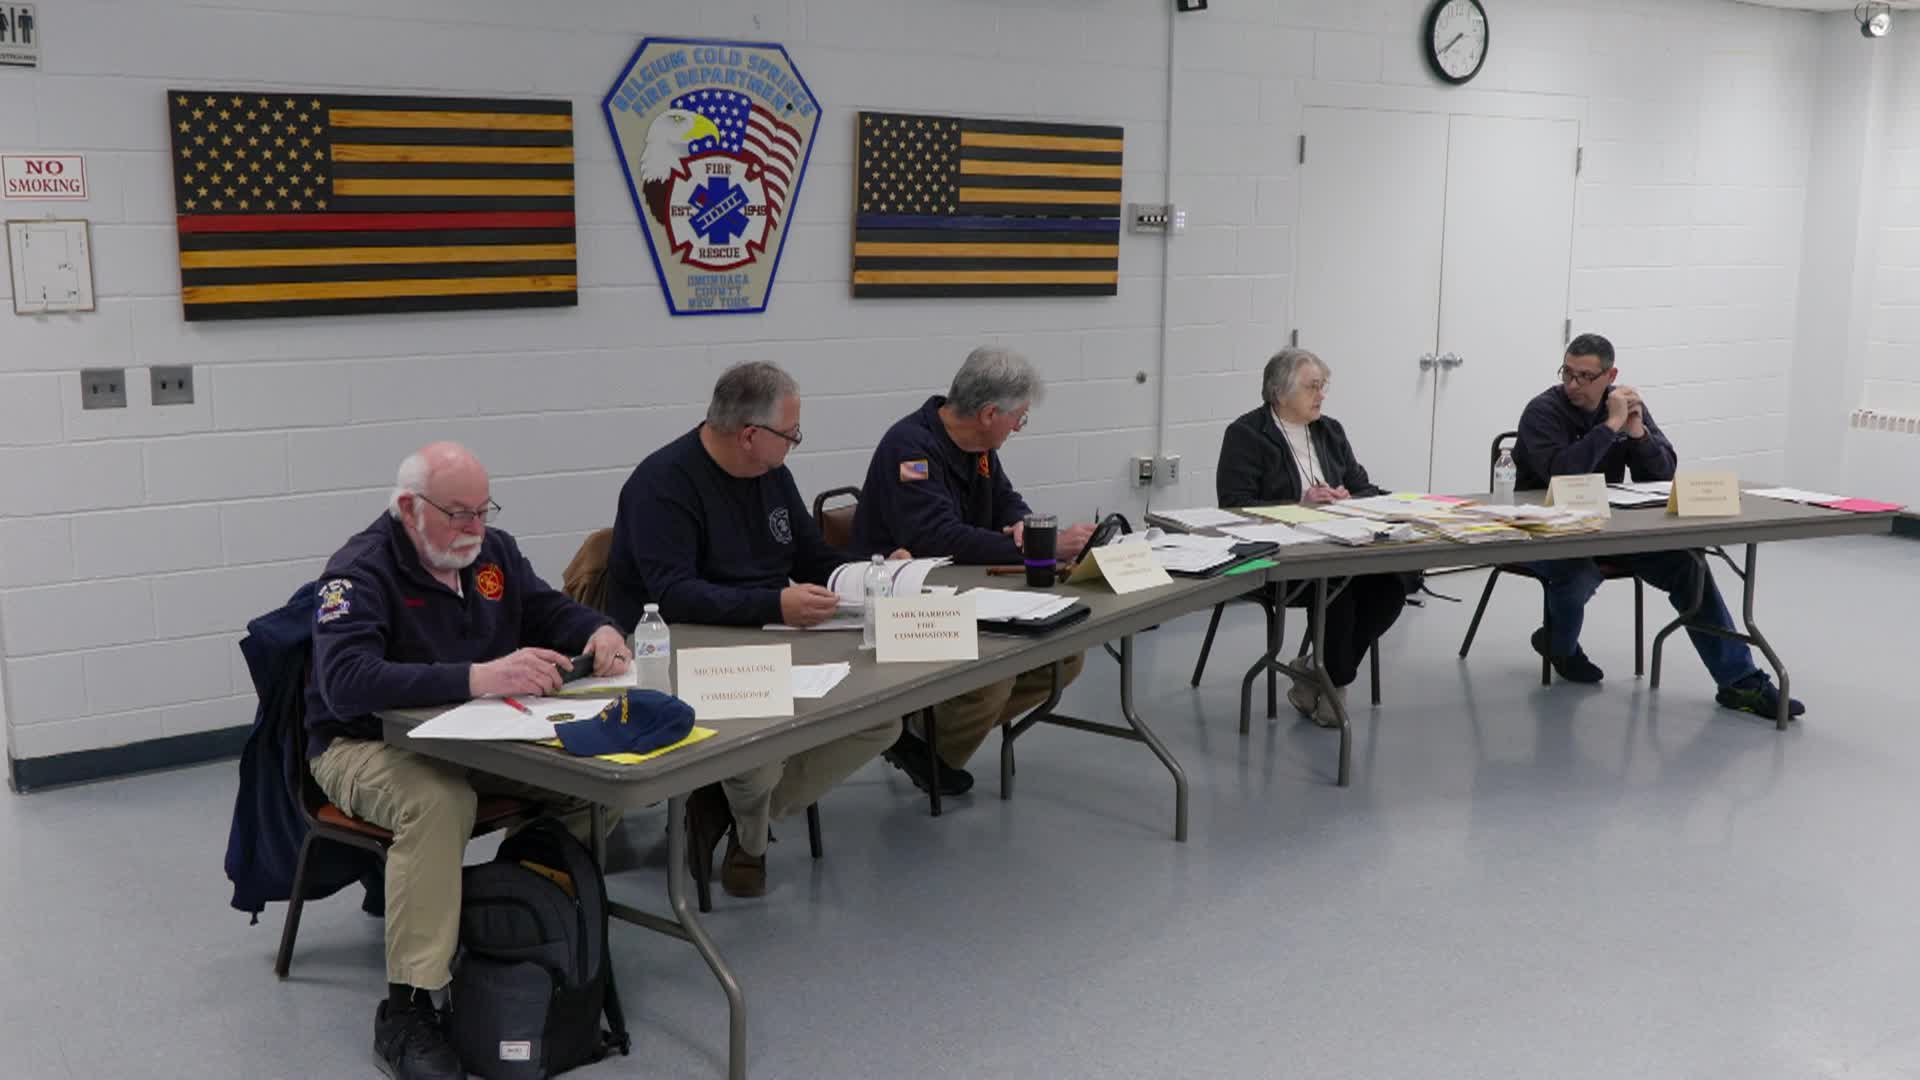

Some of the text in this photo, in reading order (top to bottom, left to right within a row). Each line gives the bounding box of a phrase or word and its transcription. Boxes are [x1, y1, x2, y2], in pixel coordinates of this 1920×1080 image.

[614, 47, 814, 117] BELGIUM COLD SPRINGS
[632, 66, 796, 119] FIRE DEPARTMENT
[25, 160, 64, 175] NO
[705, 163, 732, 174] FIRE
[9, 178, 80, 193] SMOKING
[671, 205, 694, 216] EST.
[699, 247, 741, 258] RESCUE
[687, 296, 750, 308] NEW YORK
[892, 609, 961, 619] MARK HARRISON
[894, 631, 960, 640] COMMISSIONER
[693, 663, 776, 676] MICHAEL MALONE
[700, 689, 771, 702] COMMISSIONER
